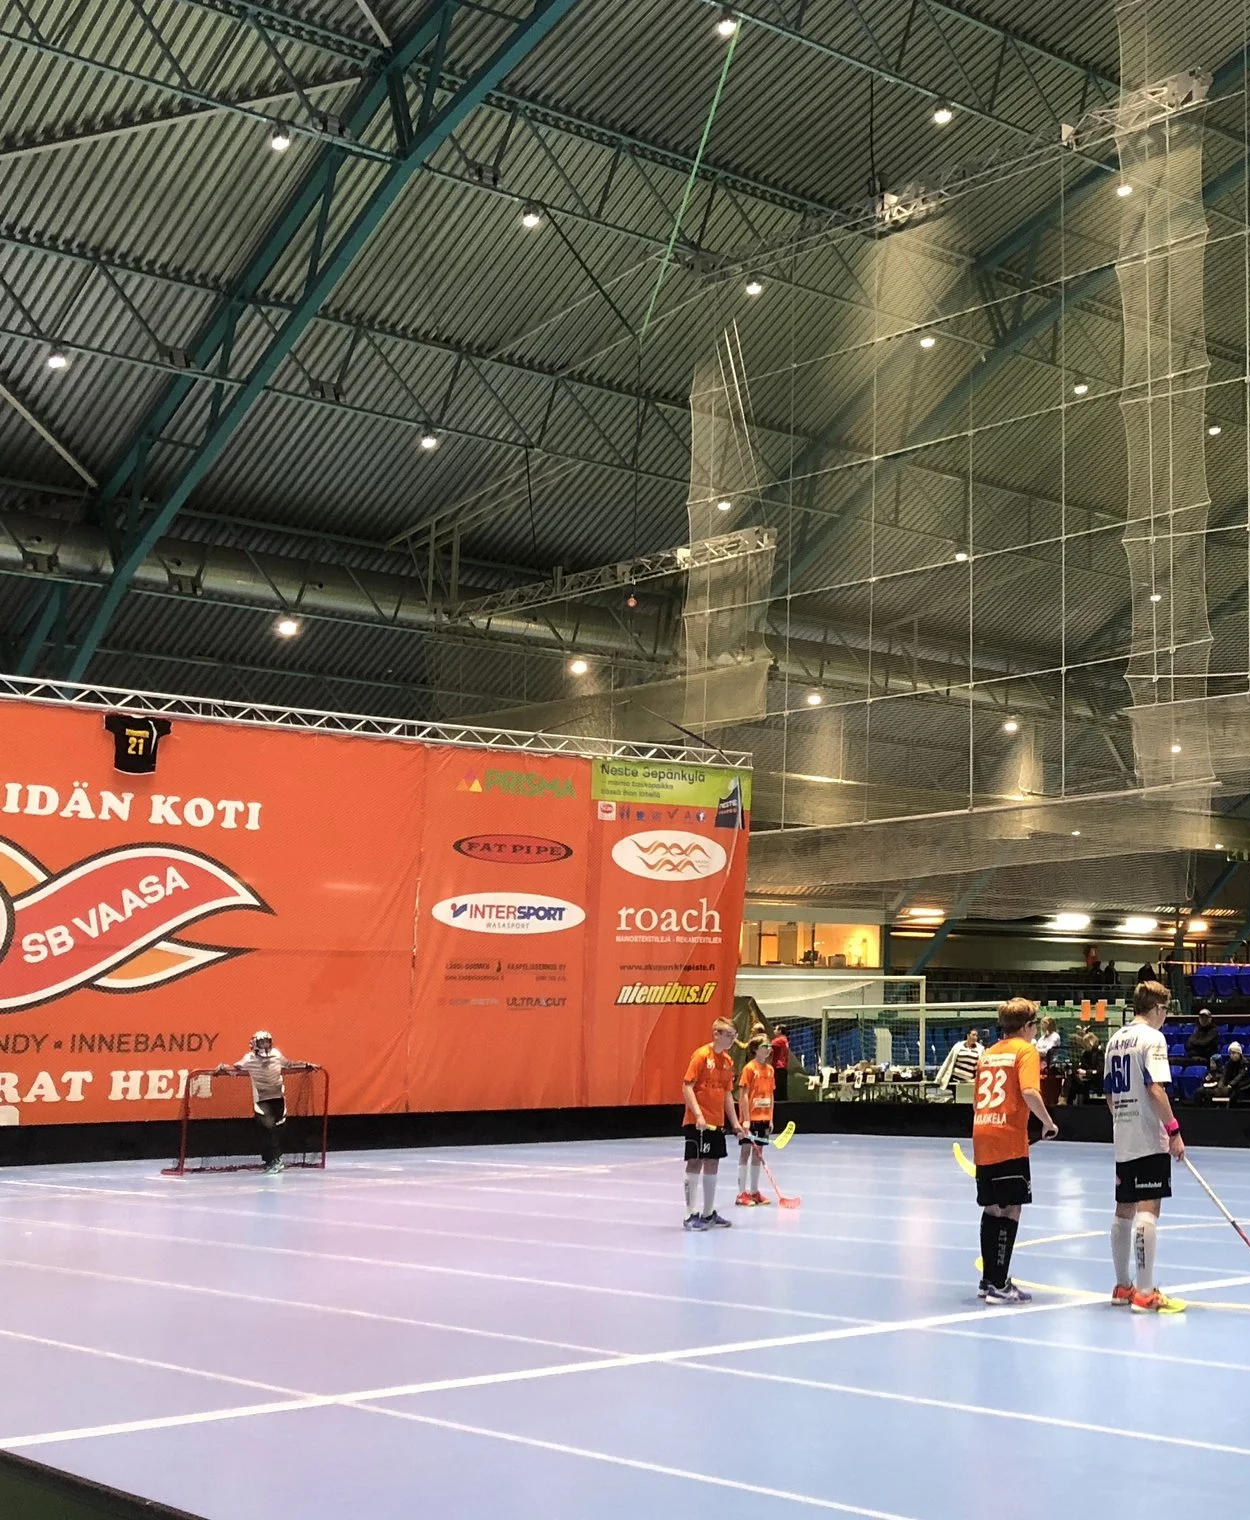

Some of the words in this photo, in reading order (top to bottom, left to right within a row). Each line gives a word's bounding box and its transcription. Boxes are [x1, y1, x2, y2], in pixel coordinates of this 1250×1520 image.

[127, 737, 145, 756] 21
[484, 768, 577, 799] PRISMA
[600, 764, 639, 778] Neste
[642, 766, 706, 785] Sepänkylä
[2, 780, 135, 822] IDÄN
[148, 794, 263, 831] KOTI
[466, 841, 507, 853] FAT
[511, 844, 563, 857] PIPE
[21, 924, 75, 964] SB
[71, 866, 190, 939] VAASA
[469, 903, 566, 921] INTERSPORT
[616, 898, 722, 933] roach
[616, 982, 717, 1005] niemibus.fi
[70, 1033, 220, 1054] INNEBANDY
[0, 1070, 93, 1104] RAT
[108, 1069, 213, 1101] HEM
[976, 1068, 1008, 1110] 33
[1111, 1053, 1131, 1094] 60
